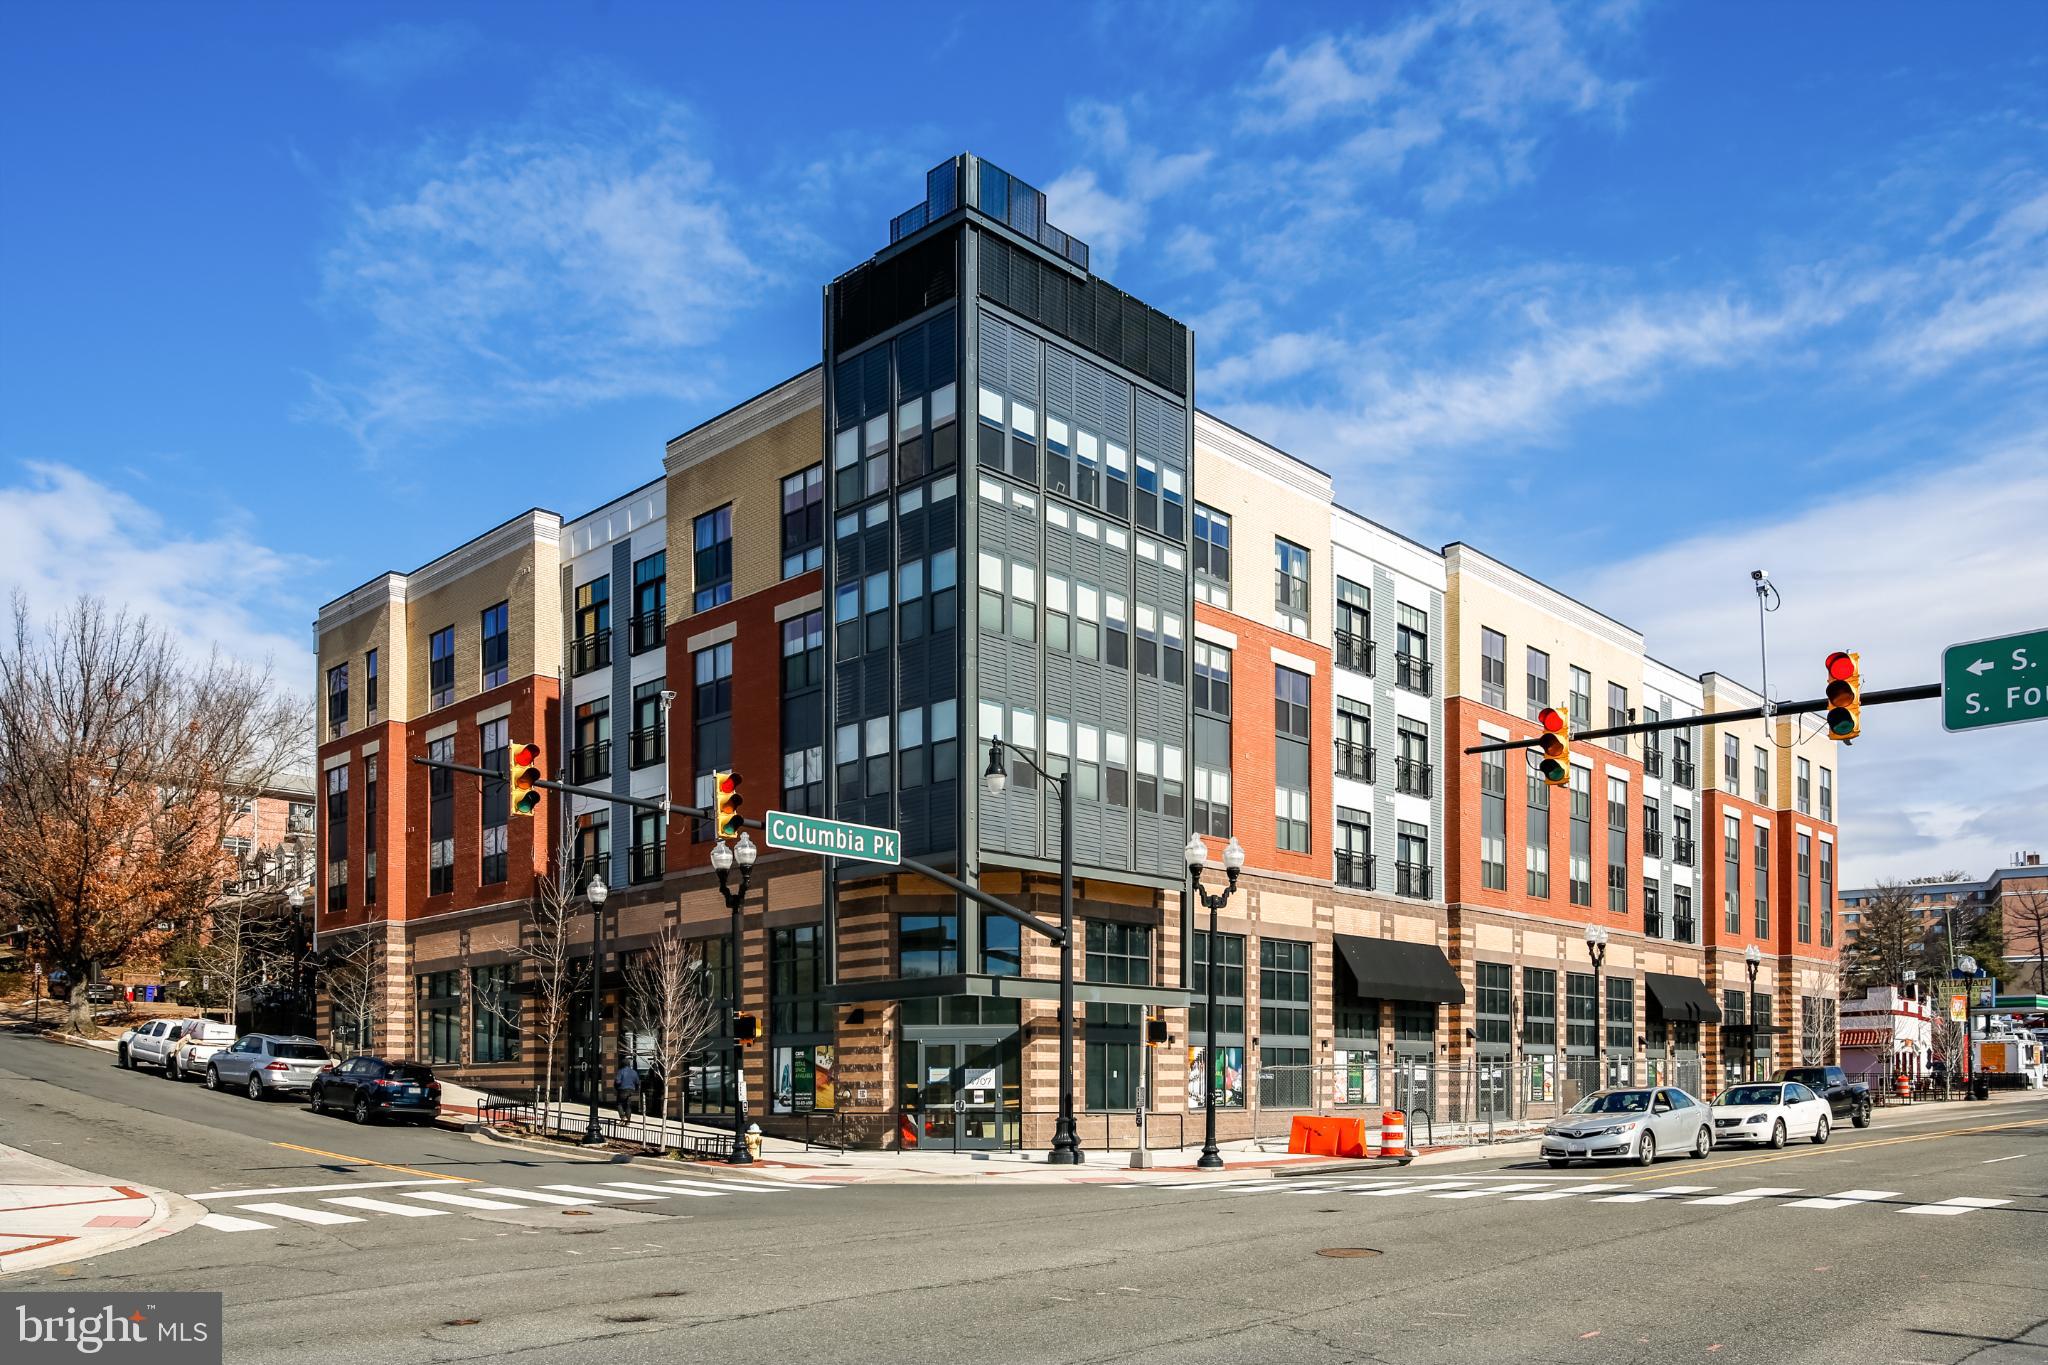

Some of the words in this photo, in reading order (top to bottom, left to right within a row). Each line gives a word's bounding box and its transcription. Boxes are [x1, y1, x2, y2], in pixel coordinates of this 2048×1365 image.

[2011, 648, 2037, 671] S.
[1965, 693, 1990, 715] S.
[2007, 685, 2048, 708] FO
[772, 819, 865, 852] Columbia
[873, 835, 895, 857] Pk
[1940, 978, 1992, 987] ATLAATL
